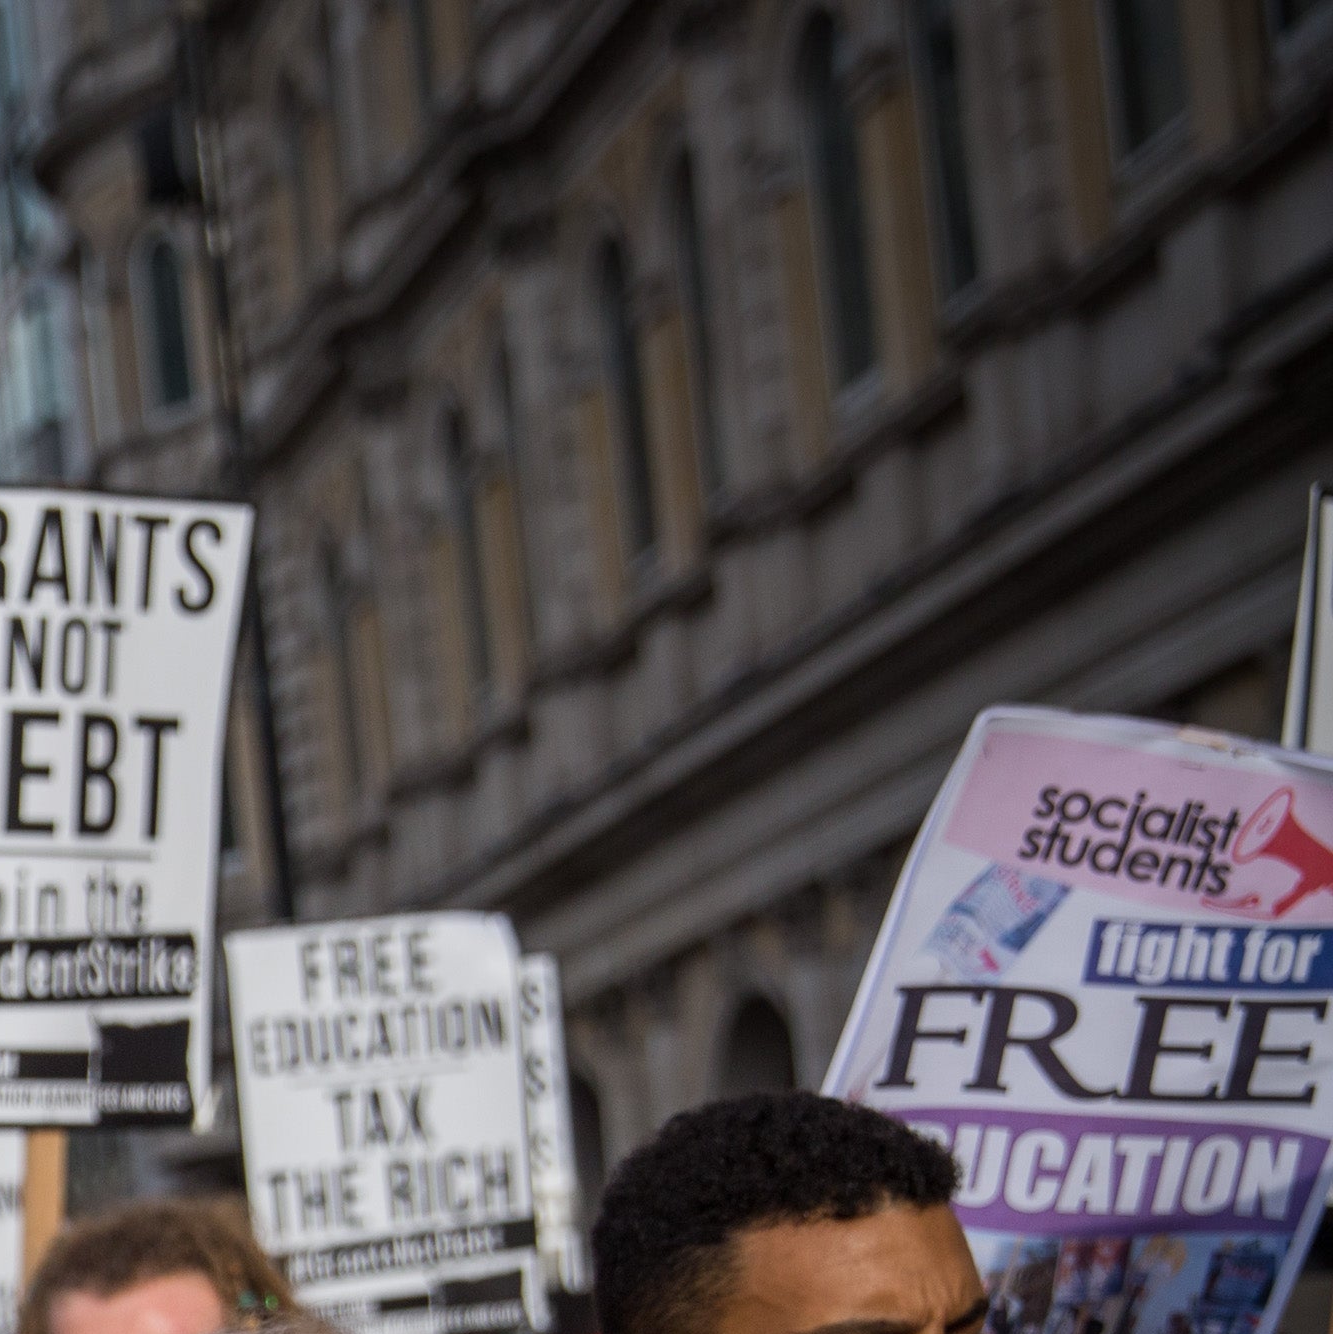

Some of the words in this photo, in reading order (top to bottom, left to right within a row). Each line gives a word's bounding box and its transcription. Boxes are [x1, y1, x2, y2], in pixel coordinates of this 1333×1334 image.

[4, 615, 123, 696] NOT
[1032, 784, 1240, 853] socialist
[1017, 822, 1232, 897] students
[85, 868, 144, 934] the
[299, 931, 432, 1002] FREE
[1094, 920, 1230, 986] fight
[1237, 922, 1322, 984] for
[250, 996, 506, 1077] EDUCATION
[873, 984, 1330, 1106] FREE
[334, 1087, 431, 1150] TAX
[269, 1167, 362, 1241] THE
[384, 1149, 516, 1222] RICH
[913, 1120, 1300, 1222] UCATION
